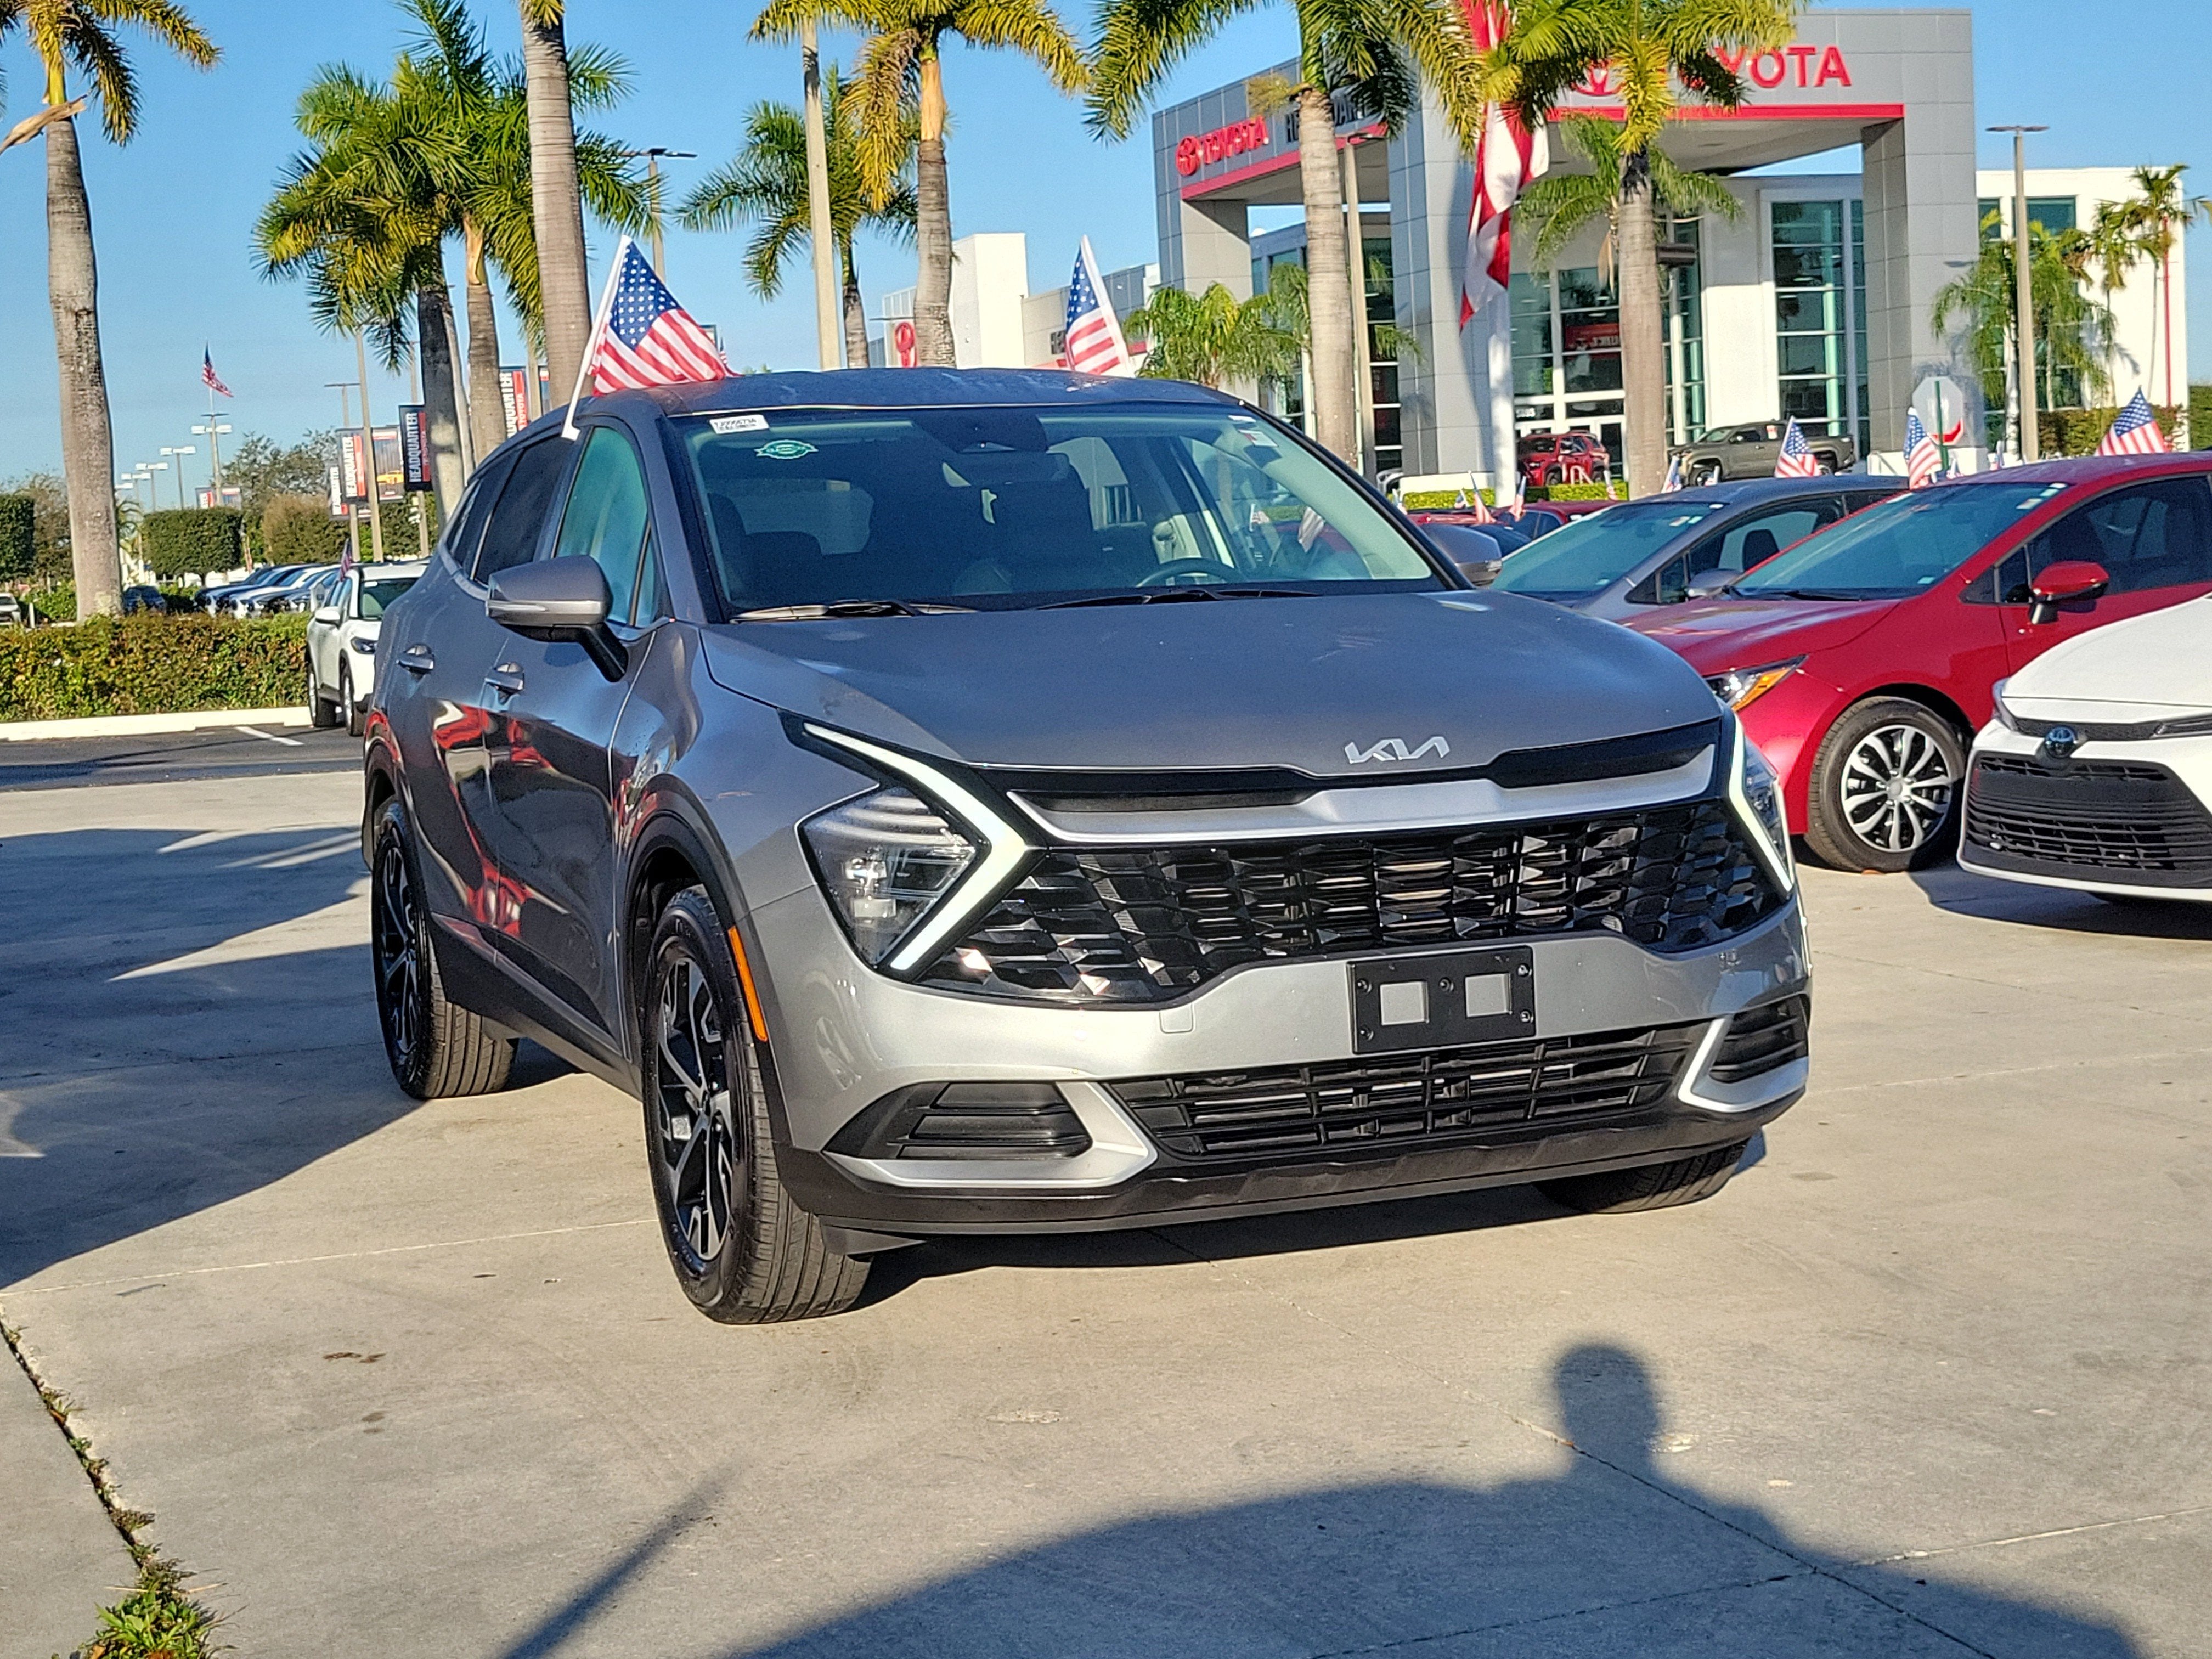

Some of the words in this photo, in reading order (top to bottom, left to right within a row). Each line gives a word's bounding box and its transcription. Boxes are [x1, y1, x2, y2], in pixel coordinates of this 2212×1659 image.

[1678, 45, 1853, 88] YOTA
[1200, 115, 1269, 165] TOYOTA
[405, 413, 424, 482] HEADQUARTER
[1345, 736, 1451, 764] KIA
